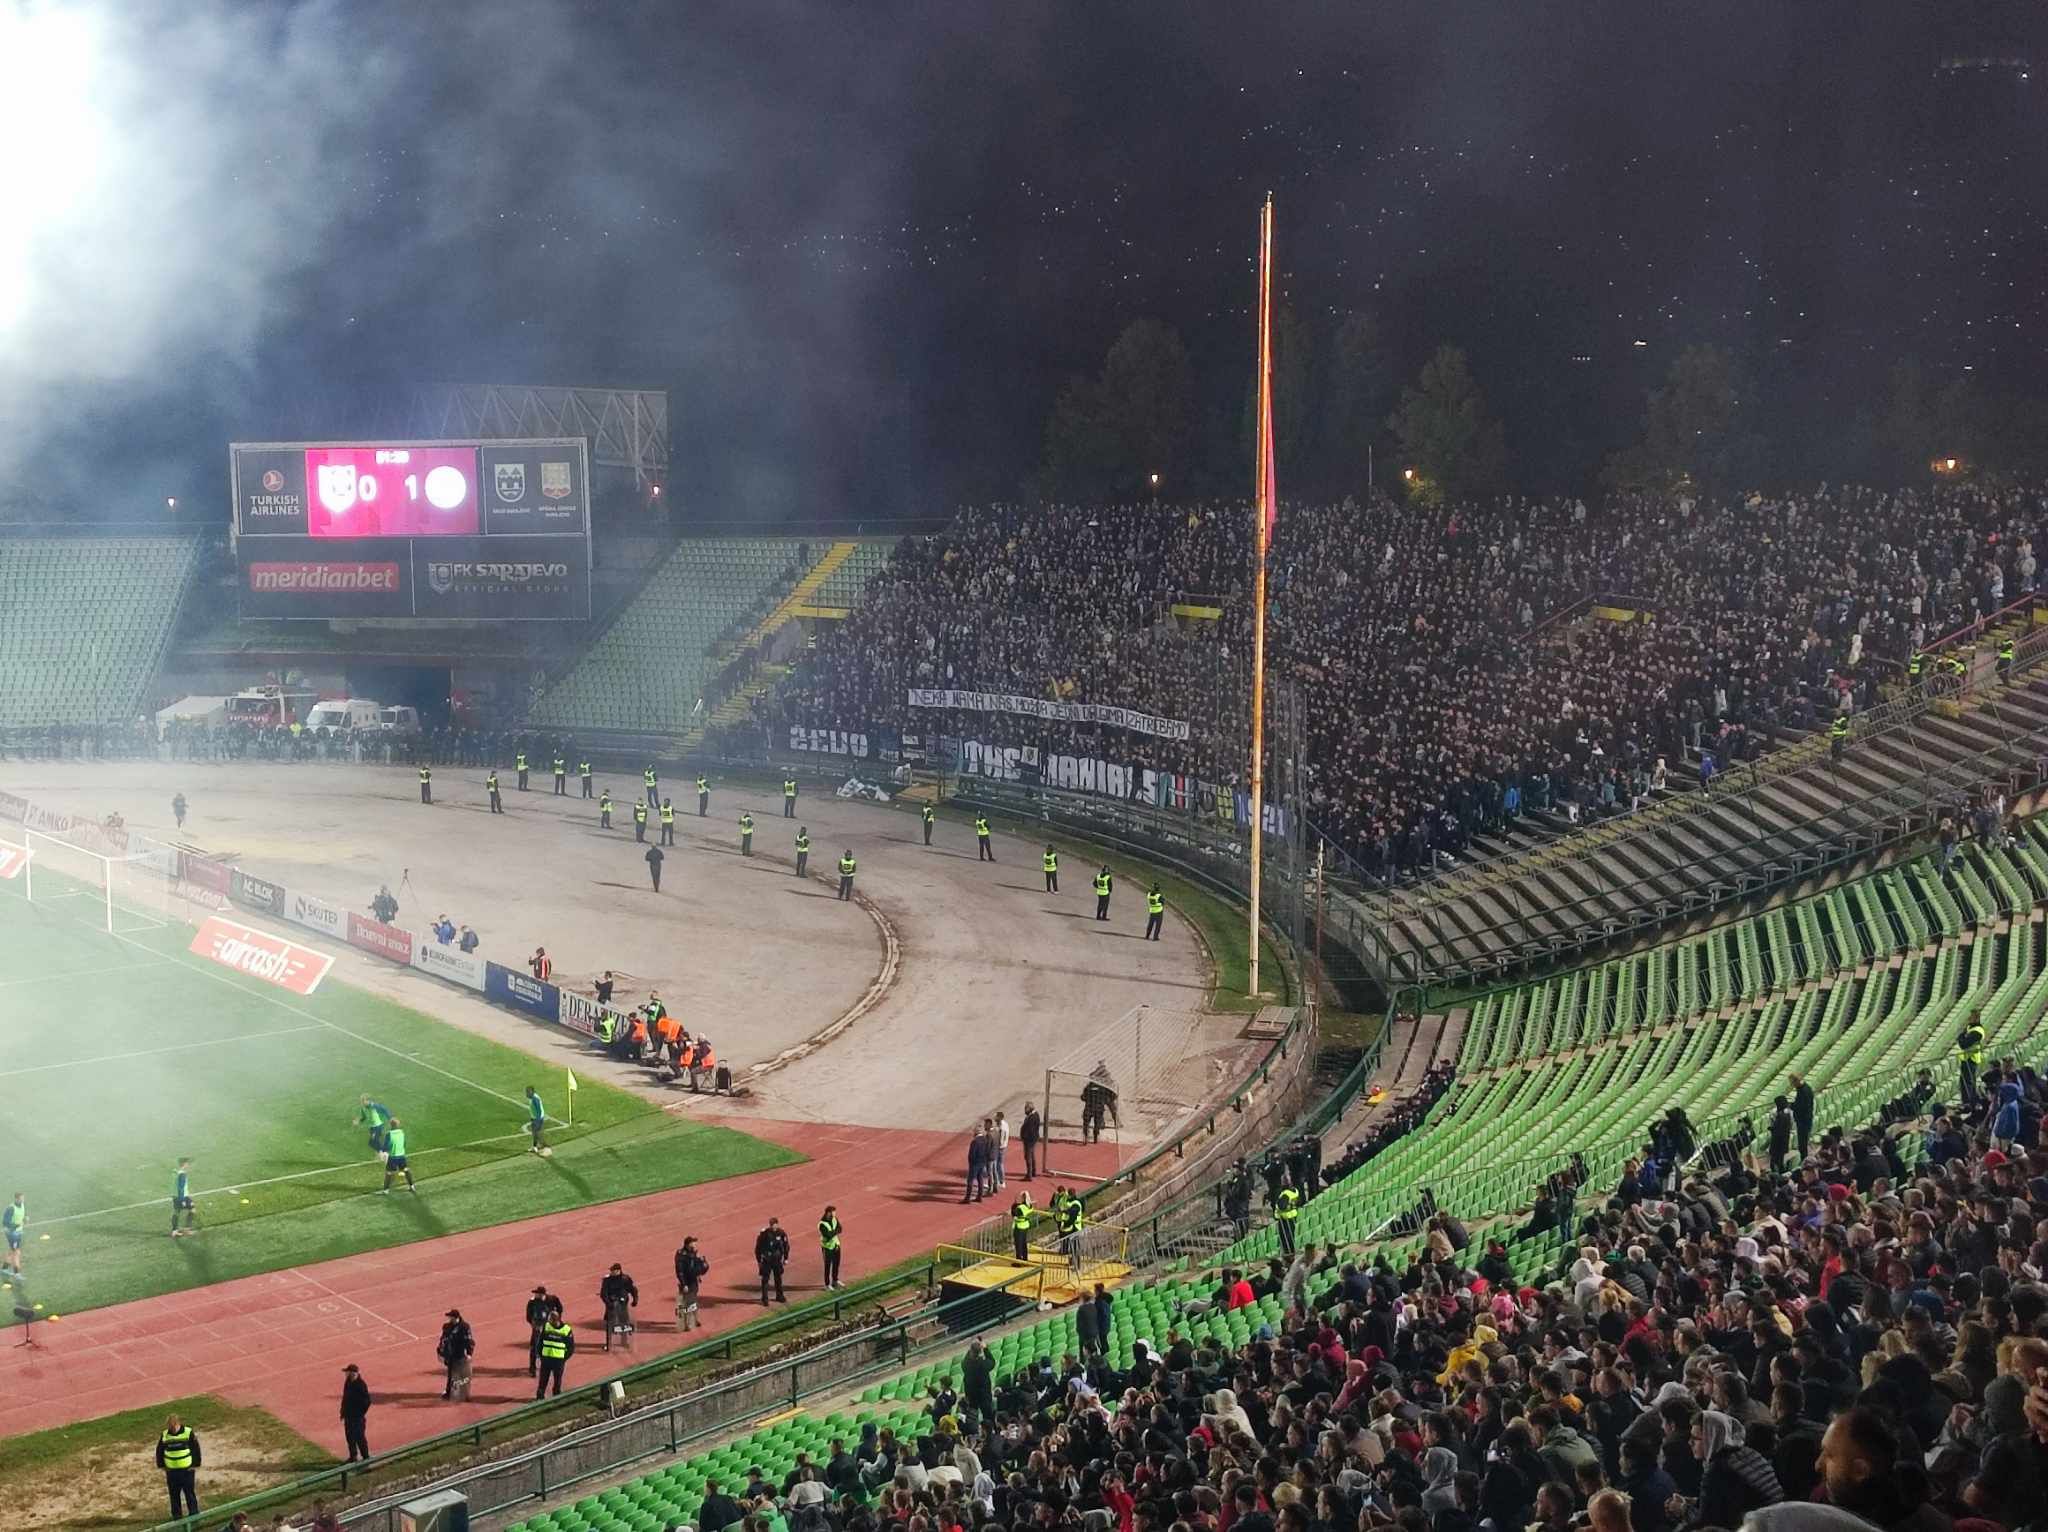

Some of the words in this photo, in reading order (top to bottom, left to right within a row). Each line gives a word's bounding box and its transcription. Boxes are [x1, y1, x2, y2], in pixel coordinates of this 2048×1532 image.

[358, 474, 377, 501] 0
[404, 474, 417, 501] 1
[250, 495, 299, 505] TURKISH
[250, 505, 300, 515] AIRLINES
[255, 565, 395, 588] meridianbet
[453, 563, 473, 577] FK
[476, 563, 568, 582] SARAJEVO
[964, 740, 1021, 780] THE
[308, 903, 338, 924] SKUTER
[220, 931, 291, 981] aircash
